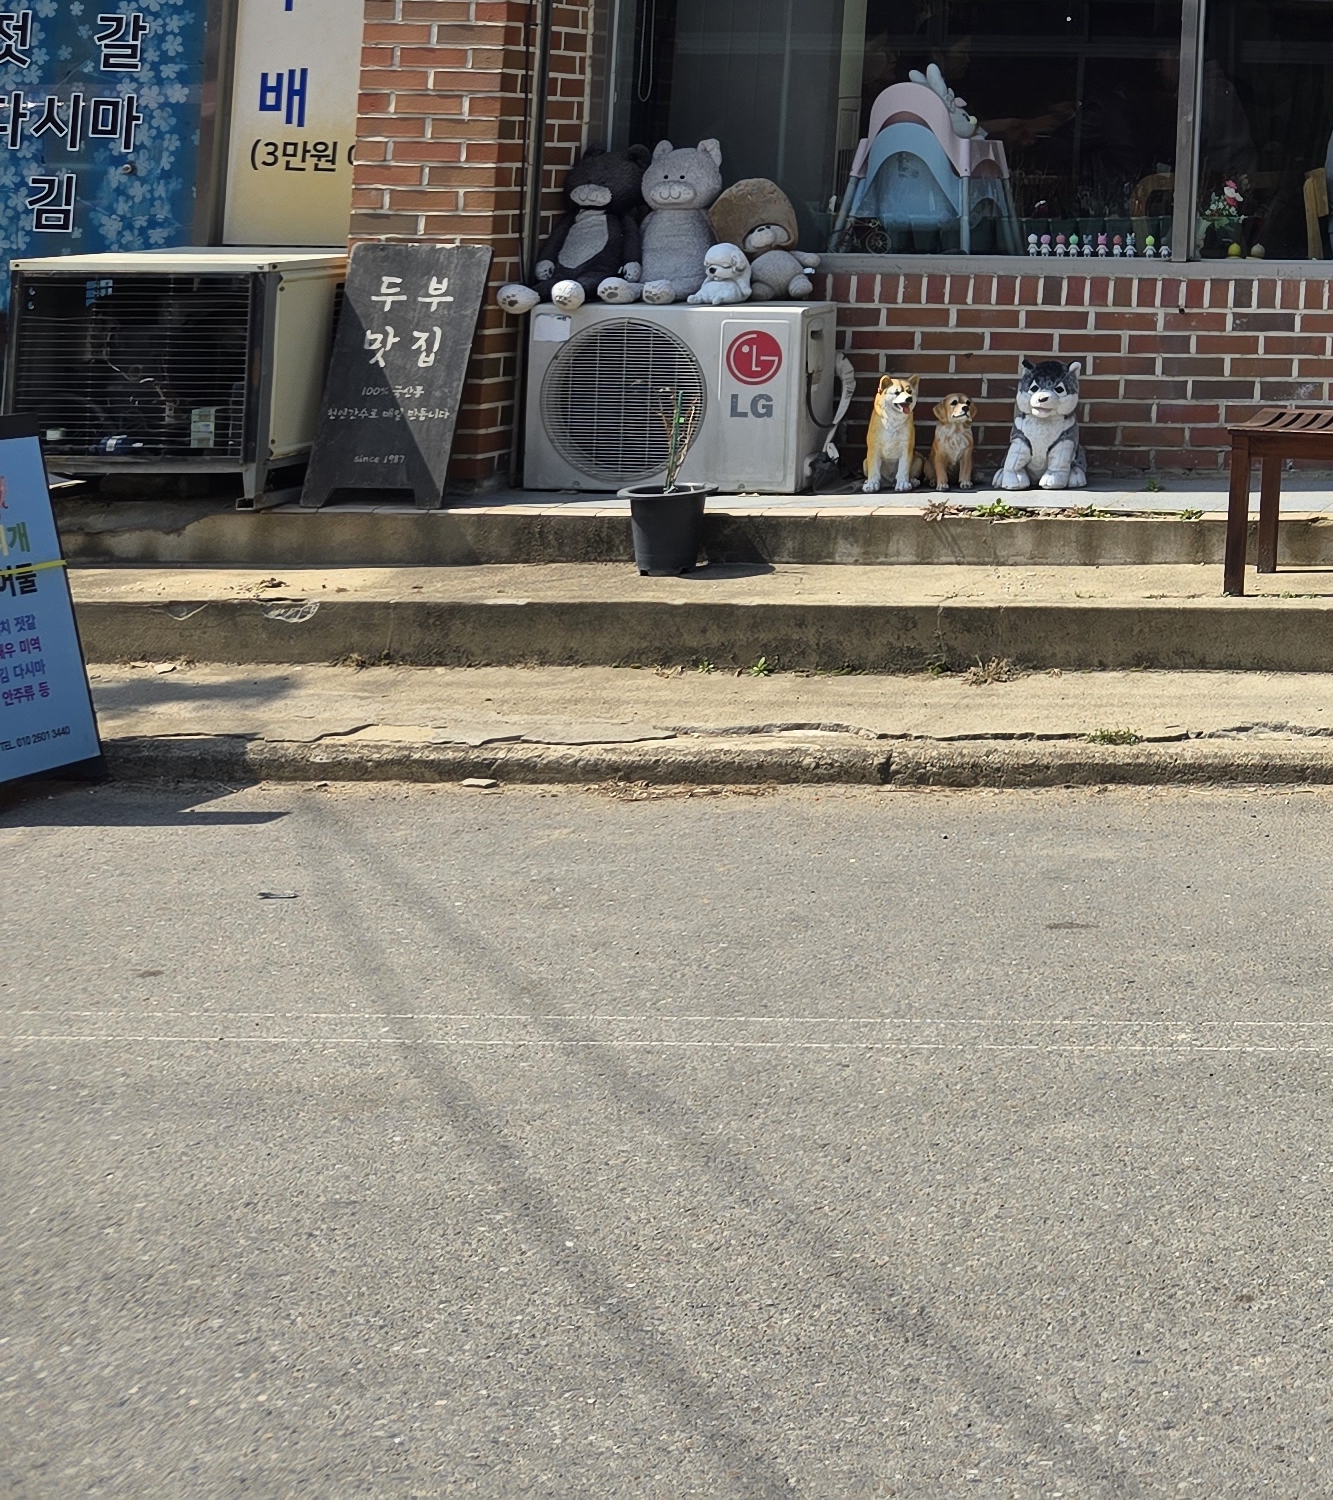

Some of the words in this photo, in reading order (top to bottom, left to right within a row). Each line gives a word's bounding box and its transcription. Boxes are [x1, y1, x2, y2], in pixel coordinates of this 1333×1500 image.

[259, 68, 308, 127] 배
[250, 139, 338, 172] (3만원
[27, 174, 76, 232] 김
[370, 276, 454, 312] 두부
[364, 326, 442, 367] 맛집
[362, 387, 389, 396] 100%
[730, 393, 774, 419] LG
[354, 455, 380, 464] since
[383, 454, 405, 464] 1987
[0, 521, 31, 557] 개
[14, 613, 36, 633] 젓갈
[19, 635, 42, 655] 미역
[13, 658, 46, 680] 다시마
[38, 681, 50, 698] 등
